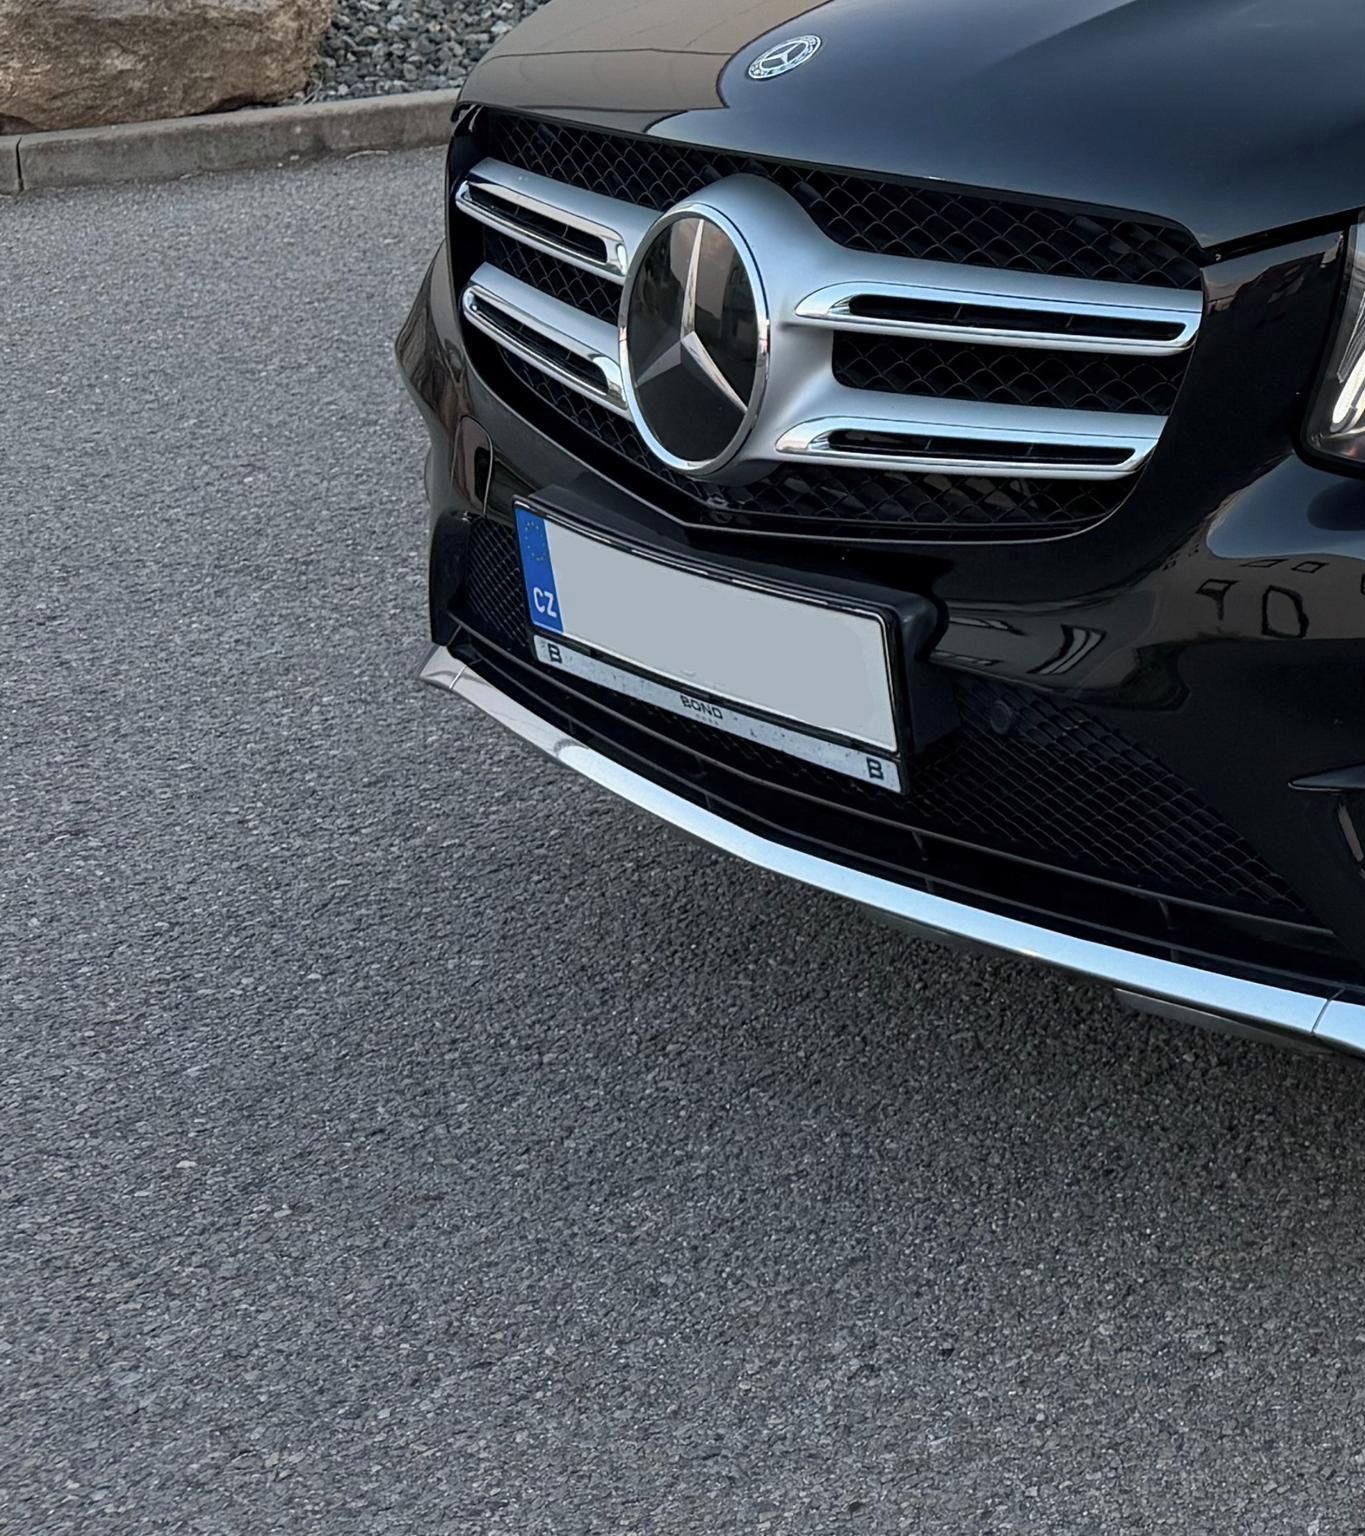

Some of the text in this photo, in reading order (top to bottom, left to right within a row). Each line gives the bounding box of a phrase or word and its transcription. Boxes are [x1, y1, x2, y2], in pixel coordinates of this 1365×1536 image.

[533, 586, 558, 618] CZ
[547, 643, 563, 663] B
[680, 694, 723, 720] BOND
[866, 756, 884, 781] B
